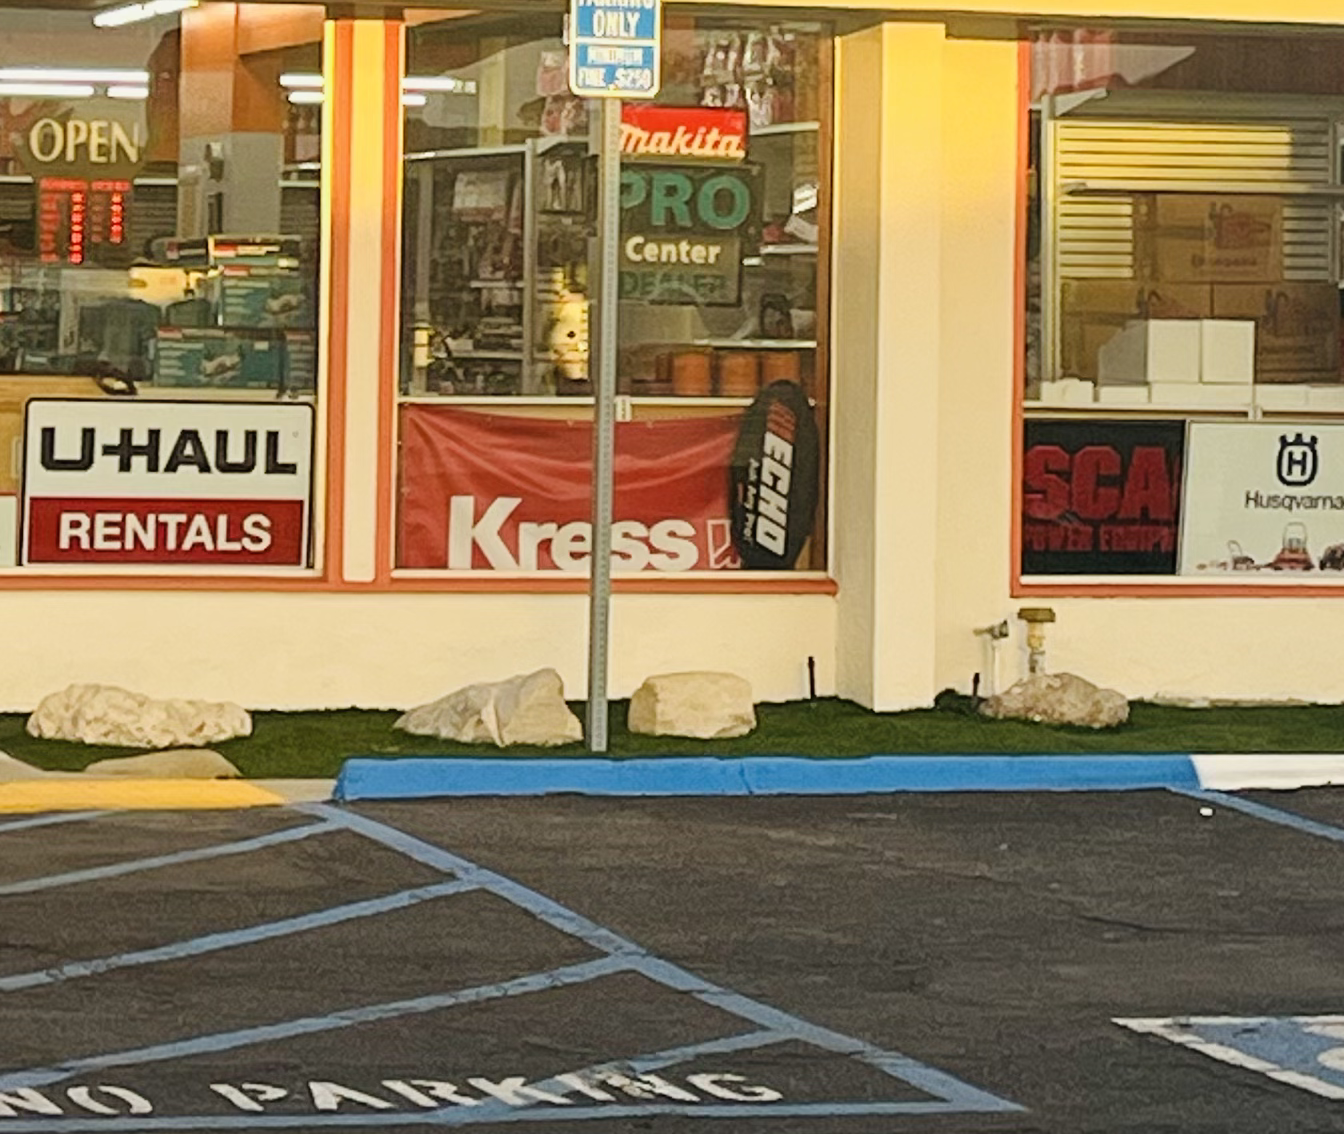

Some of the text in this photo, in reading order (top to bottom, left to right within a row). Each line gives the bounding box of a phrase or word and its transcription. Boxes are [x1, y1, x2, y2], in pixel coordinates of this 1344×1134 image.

[592, 9, 641, 37] ONLY
[28, 117, 140, 164] OPEN
[625, 234, 722, 265] Center
[40, 426, 298, 475] U-HAUL
[755, 430, 794, 557] ECHO
[1024, 444, 1180, 520] SCA
[59, 512, 273, 552] RENTALS
[448, 494, 700, 572] Kress
[209, 1070, 784, 1113] PARKING
